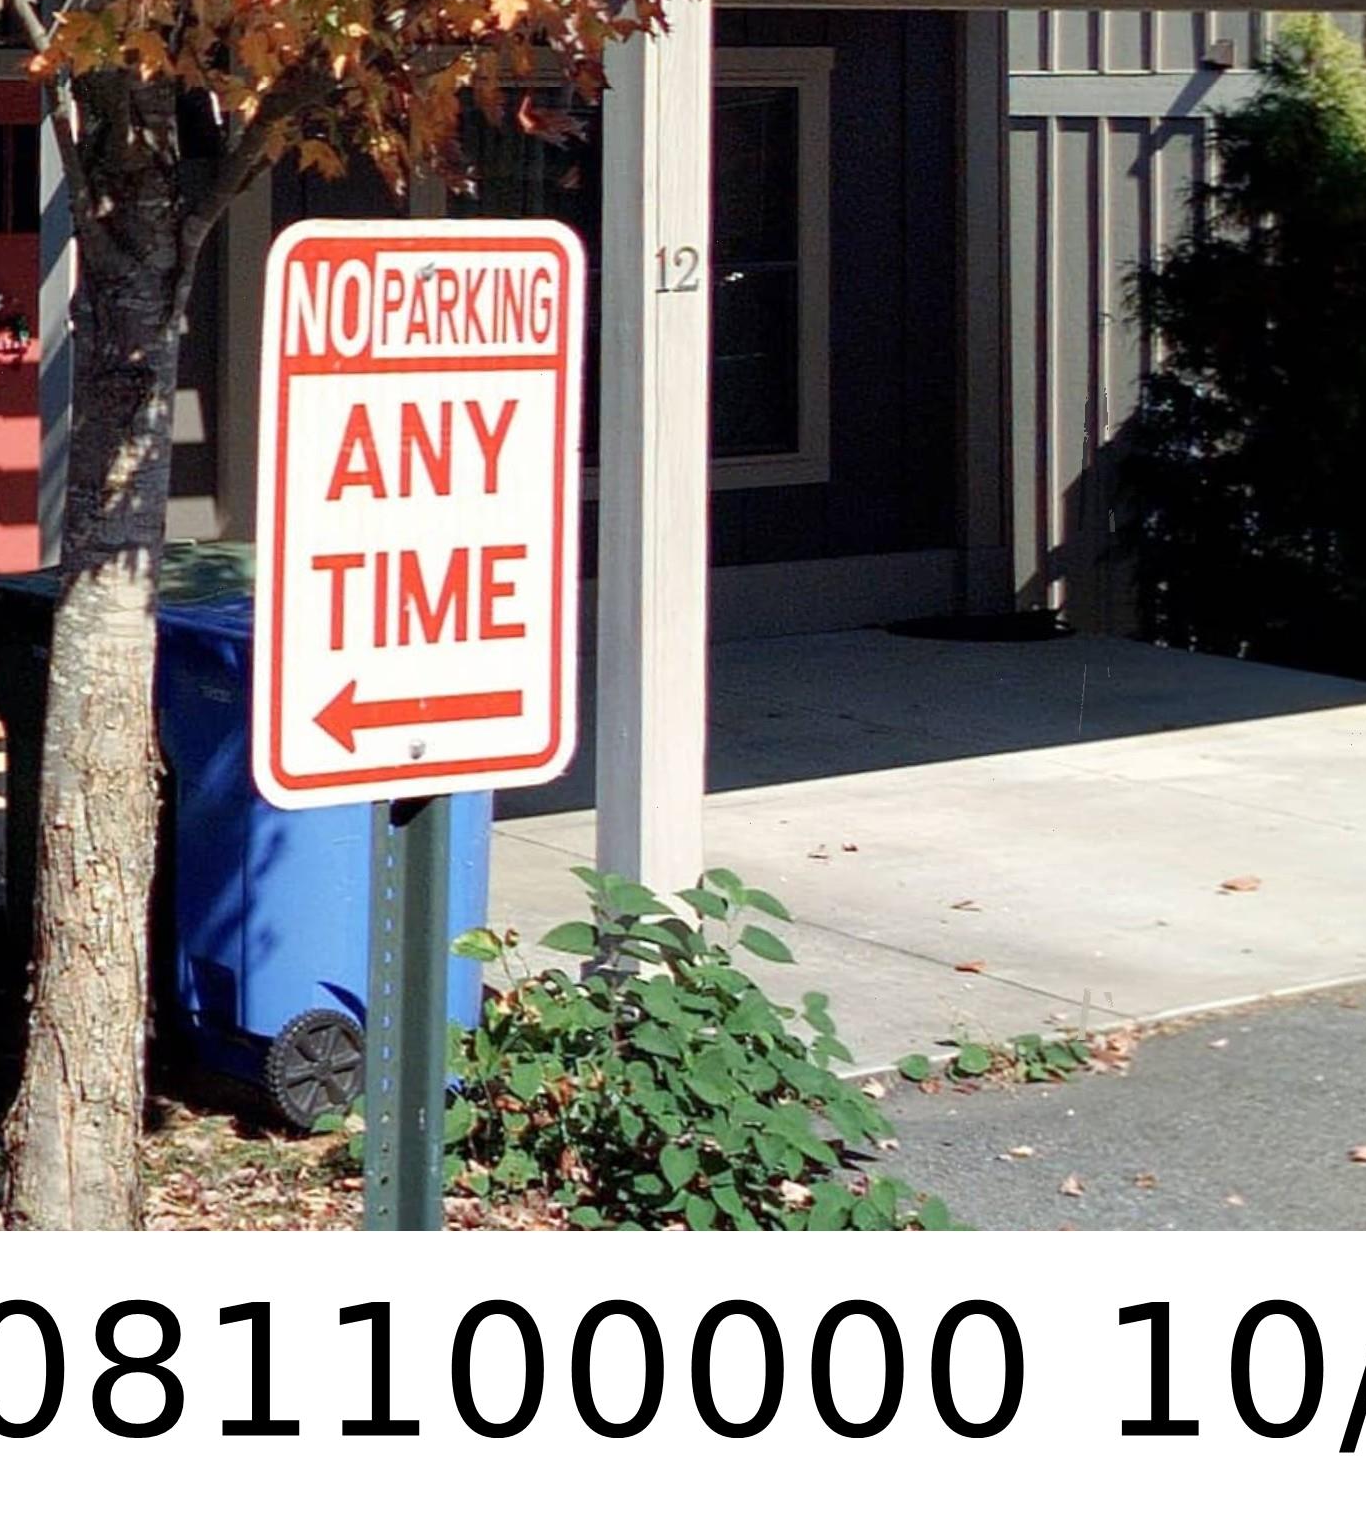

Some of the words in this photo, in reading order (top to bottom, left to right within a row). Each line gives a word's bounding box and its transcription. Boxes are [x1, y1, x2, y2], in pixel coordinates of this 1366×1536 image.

[286, 259, 373, 358] NO
[382, 267, 552, 345] PARKING
[655, 246, 699, 293] 12
[326, 399, 518, 501] ANY
[312, 544, 527, 650] TIME
